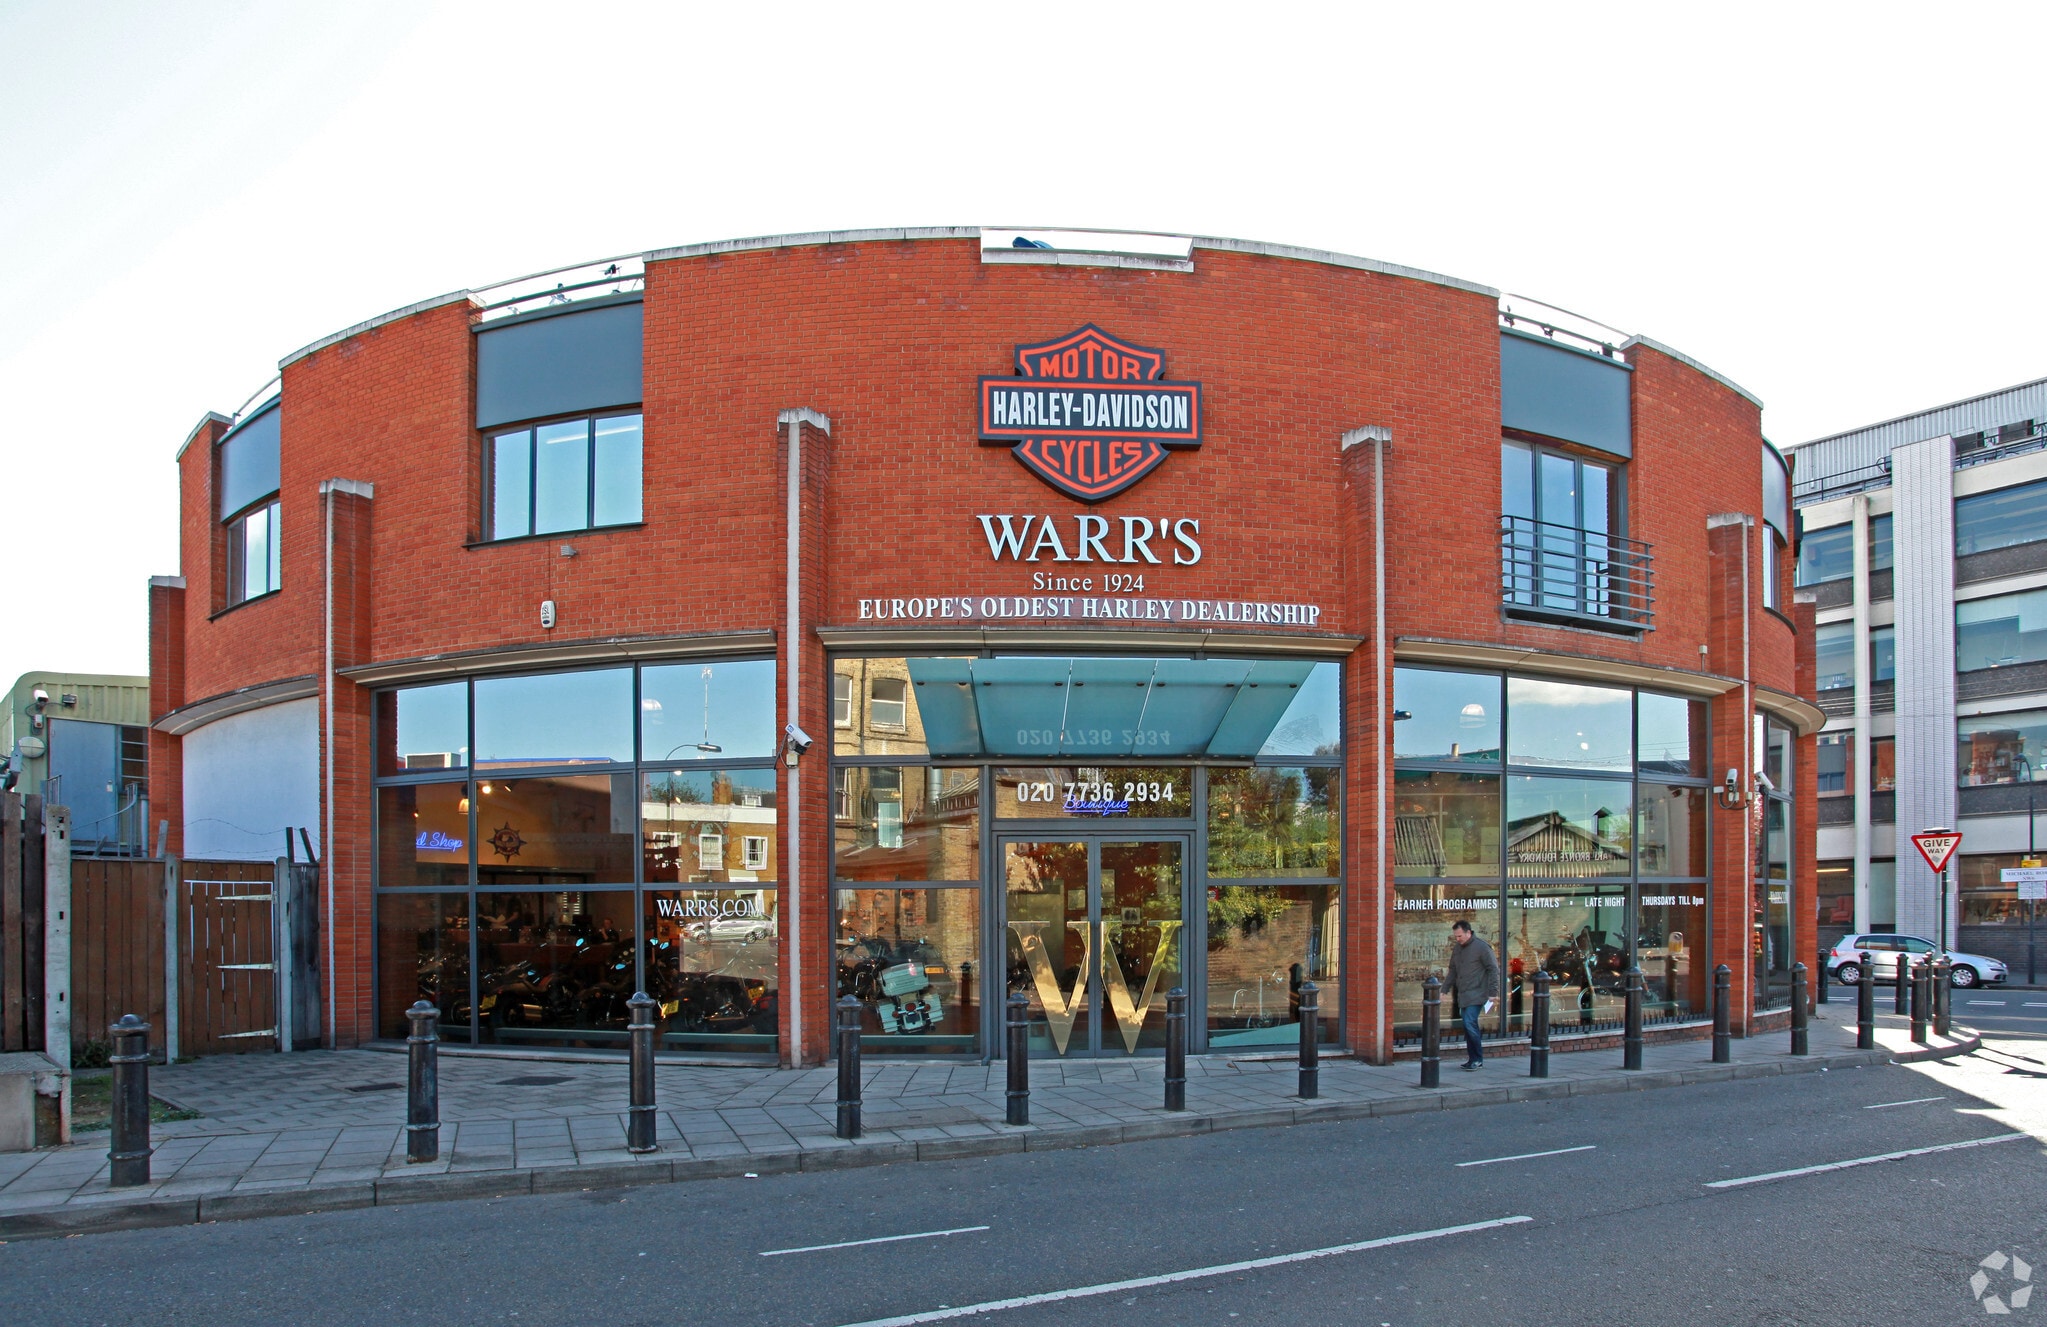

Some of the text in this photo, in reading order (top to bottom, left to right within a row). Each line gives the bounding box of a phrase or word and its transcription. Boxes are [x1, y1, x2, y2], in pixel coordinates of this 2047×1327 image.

[1040, 340, 1141, 380] MOTOR
[993, 390, 1188, 430] HARLEY-DAVIDSON
[1041, 440, 1142, 484] CYCLES
[976, 514, 1202, 566] WARR'S
[1032, 572, 1145, 592] Since 1924
[858, 597, 1321, 625] EUROPE'S OLDEST HARLEY DEALERSHIP
[1017, 782, 1174, 802] 020 7736 2934
[429, 831, 463, 853] Shop
[1923, 838, 1951, 847] GIVE
[1393, 899, 1434, 910] LEARNER
[1436, 898, 1498, 910] PROGRAMMES
[1523, 898, 1560, 908] RENTALS
[1584, 897, 1602, 907] LATE
[1604, 897, 1626, 907] NIGHT
[1641, 896, 1676, 906] THURSDAYS
[1679, 895, 1691, 905] TILL
